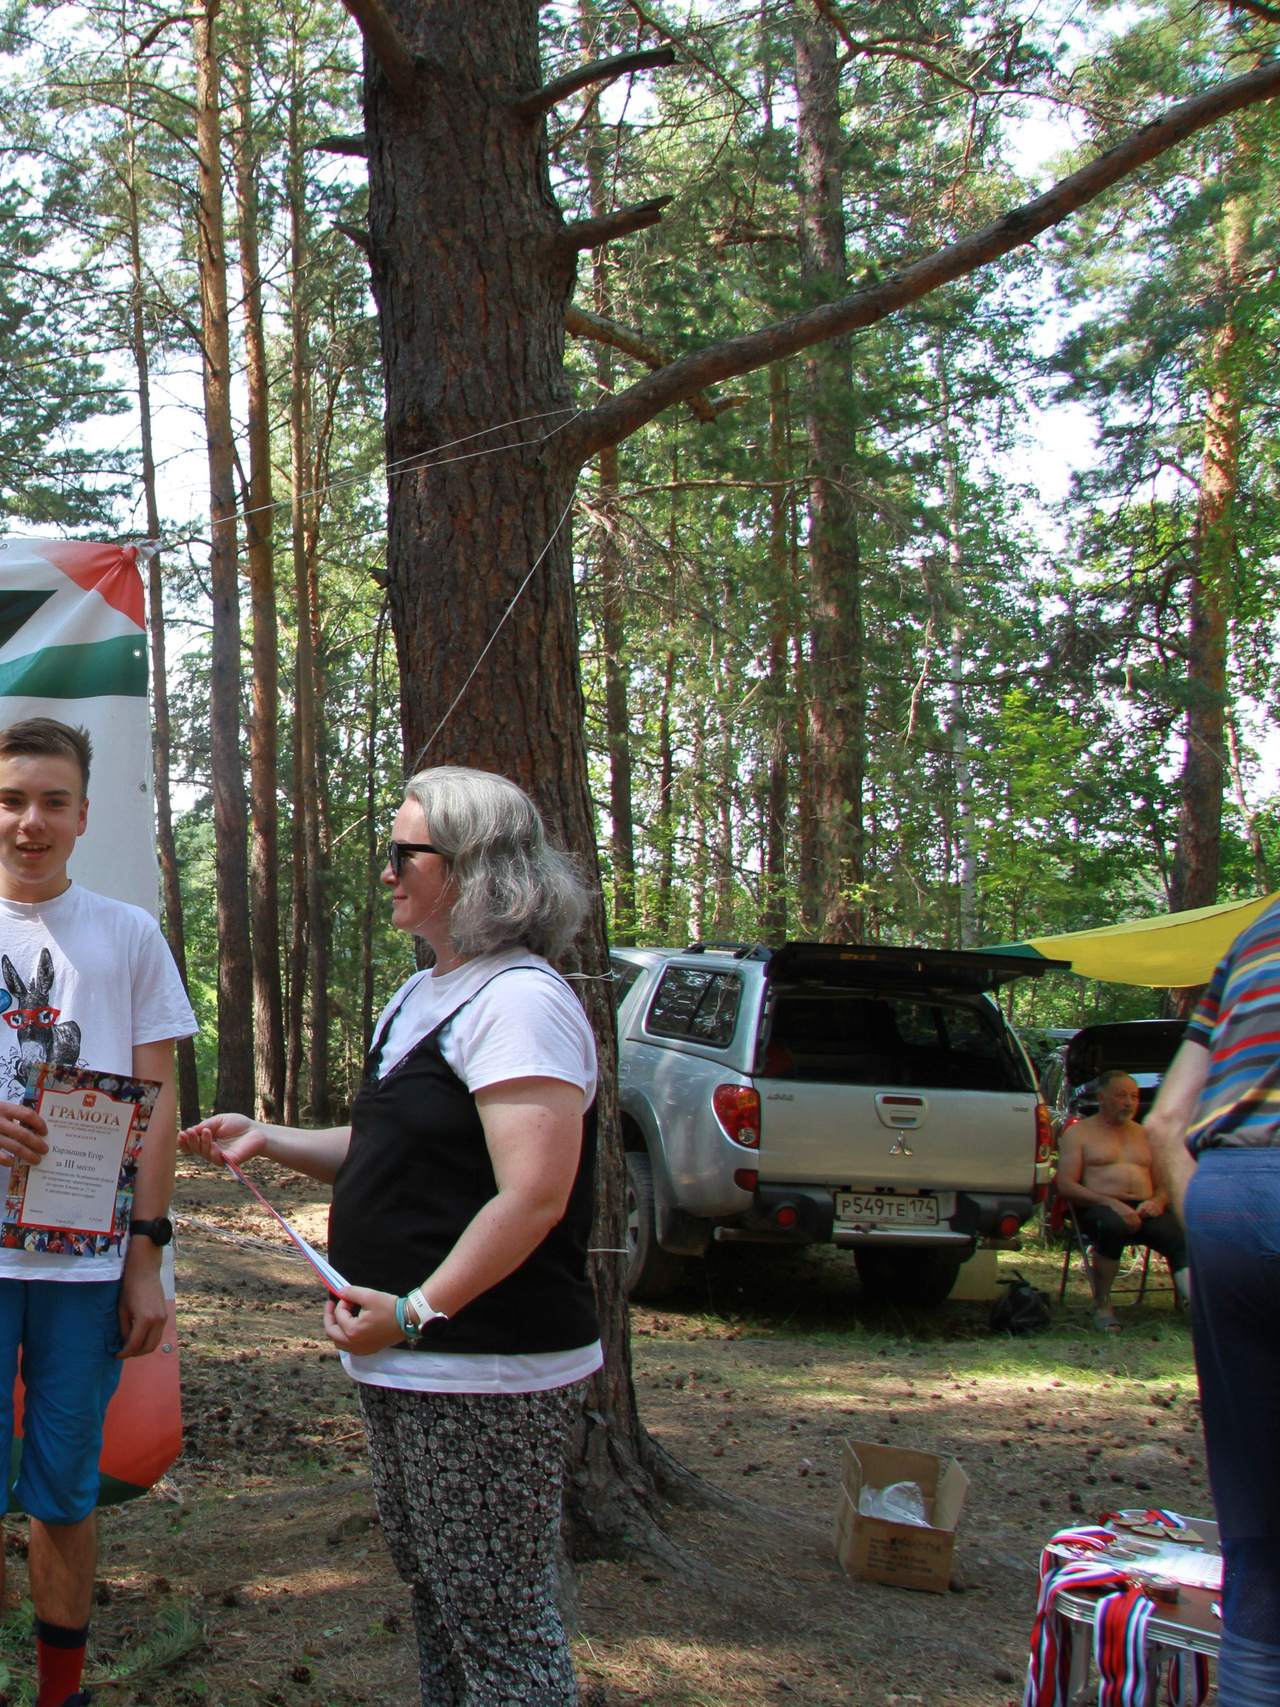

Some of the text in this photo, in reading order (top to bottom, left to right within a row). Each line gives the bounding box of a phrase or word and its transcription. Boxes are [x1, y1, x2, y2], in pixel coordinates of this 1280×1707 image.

[49, 1104, 120, 1126] ГРАМОТА
[87, 1151, 104, 1160] Егор
[909, 1199, 934, 1213] 174
